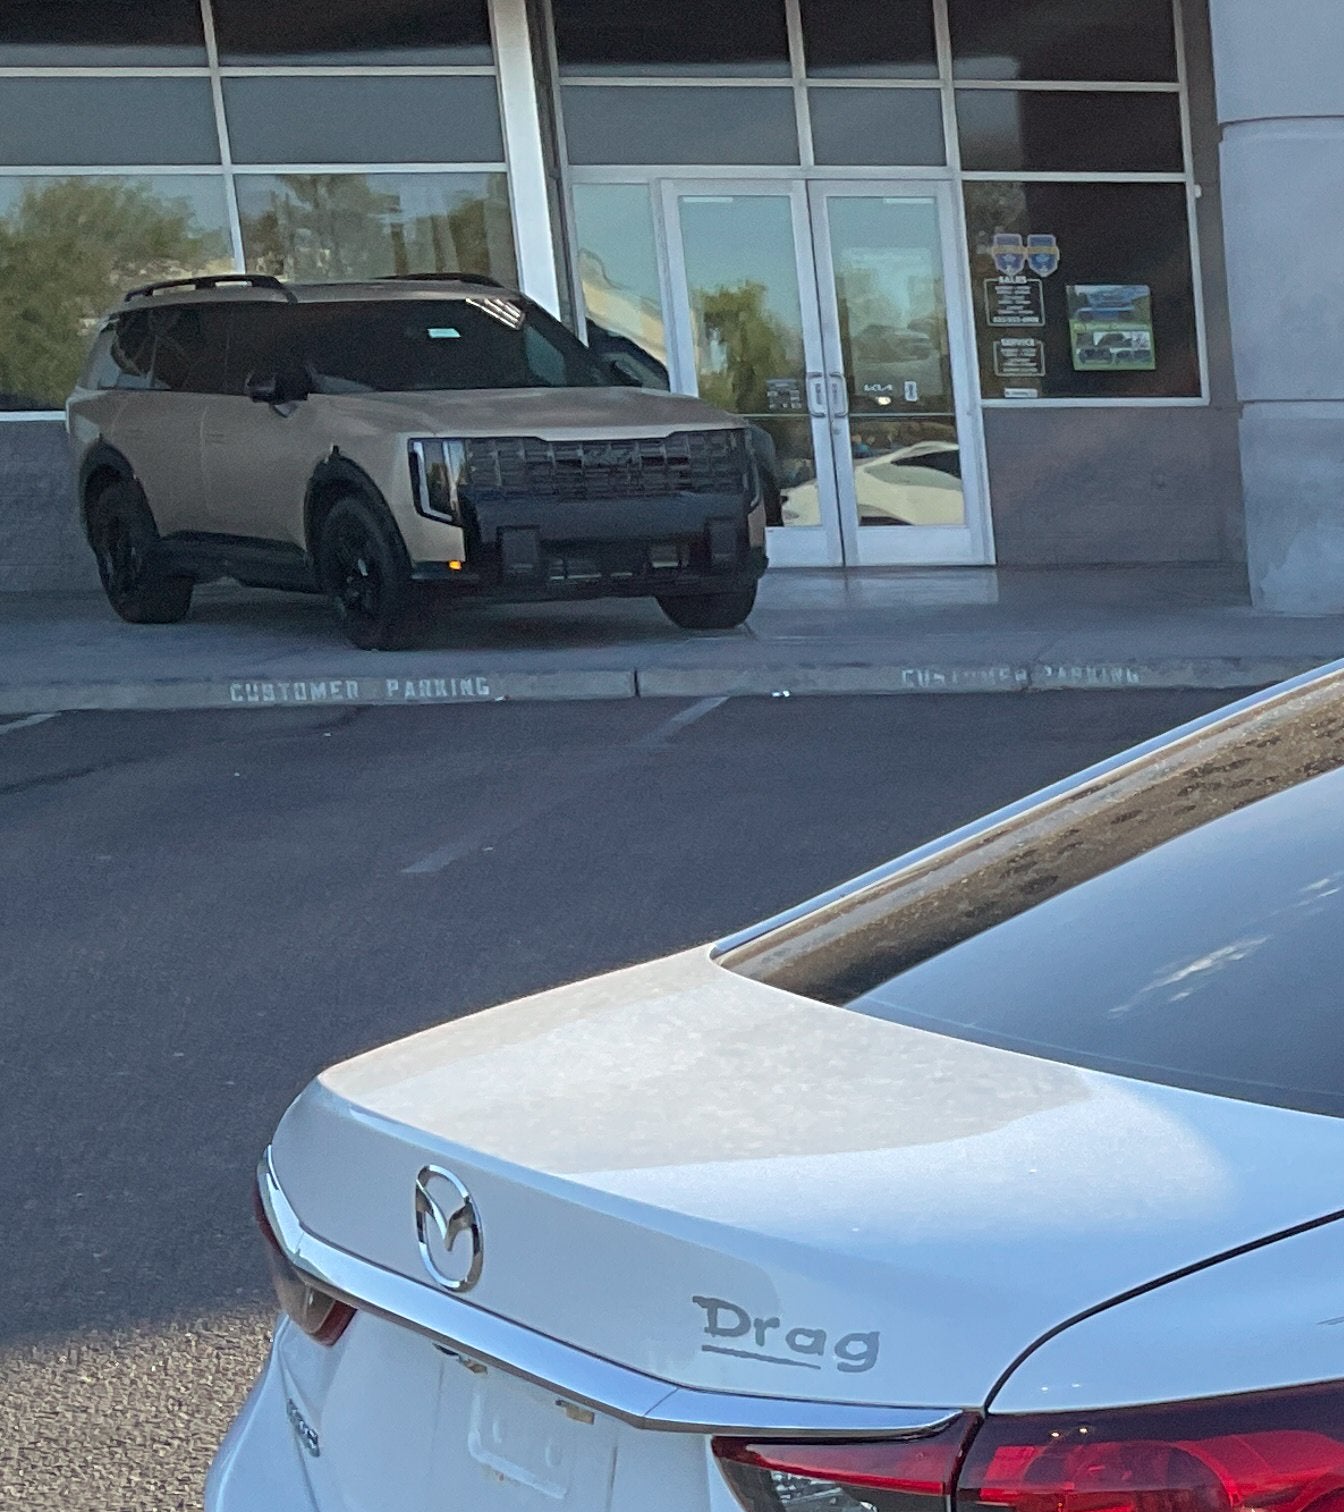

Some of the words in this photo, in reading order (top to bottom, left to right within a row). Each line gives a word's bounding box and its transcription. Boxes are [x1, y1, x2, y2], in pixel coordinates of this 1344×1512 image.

[229, 680, 360, 701] CUSTOMER
[386, 676, 490, 698] PARKING
[692, 1295, 880, 1373] Drag
